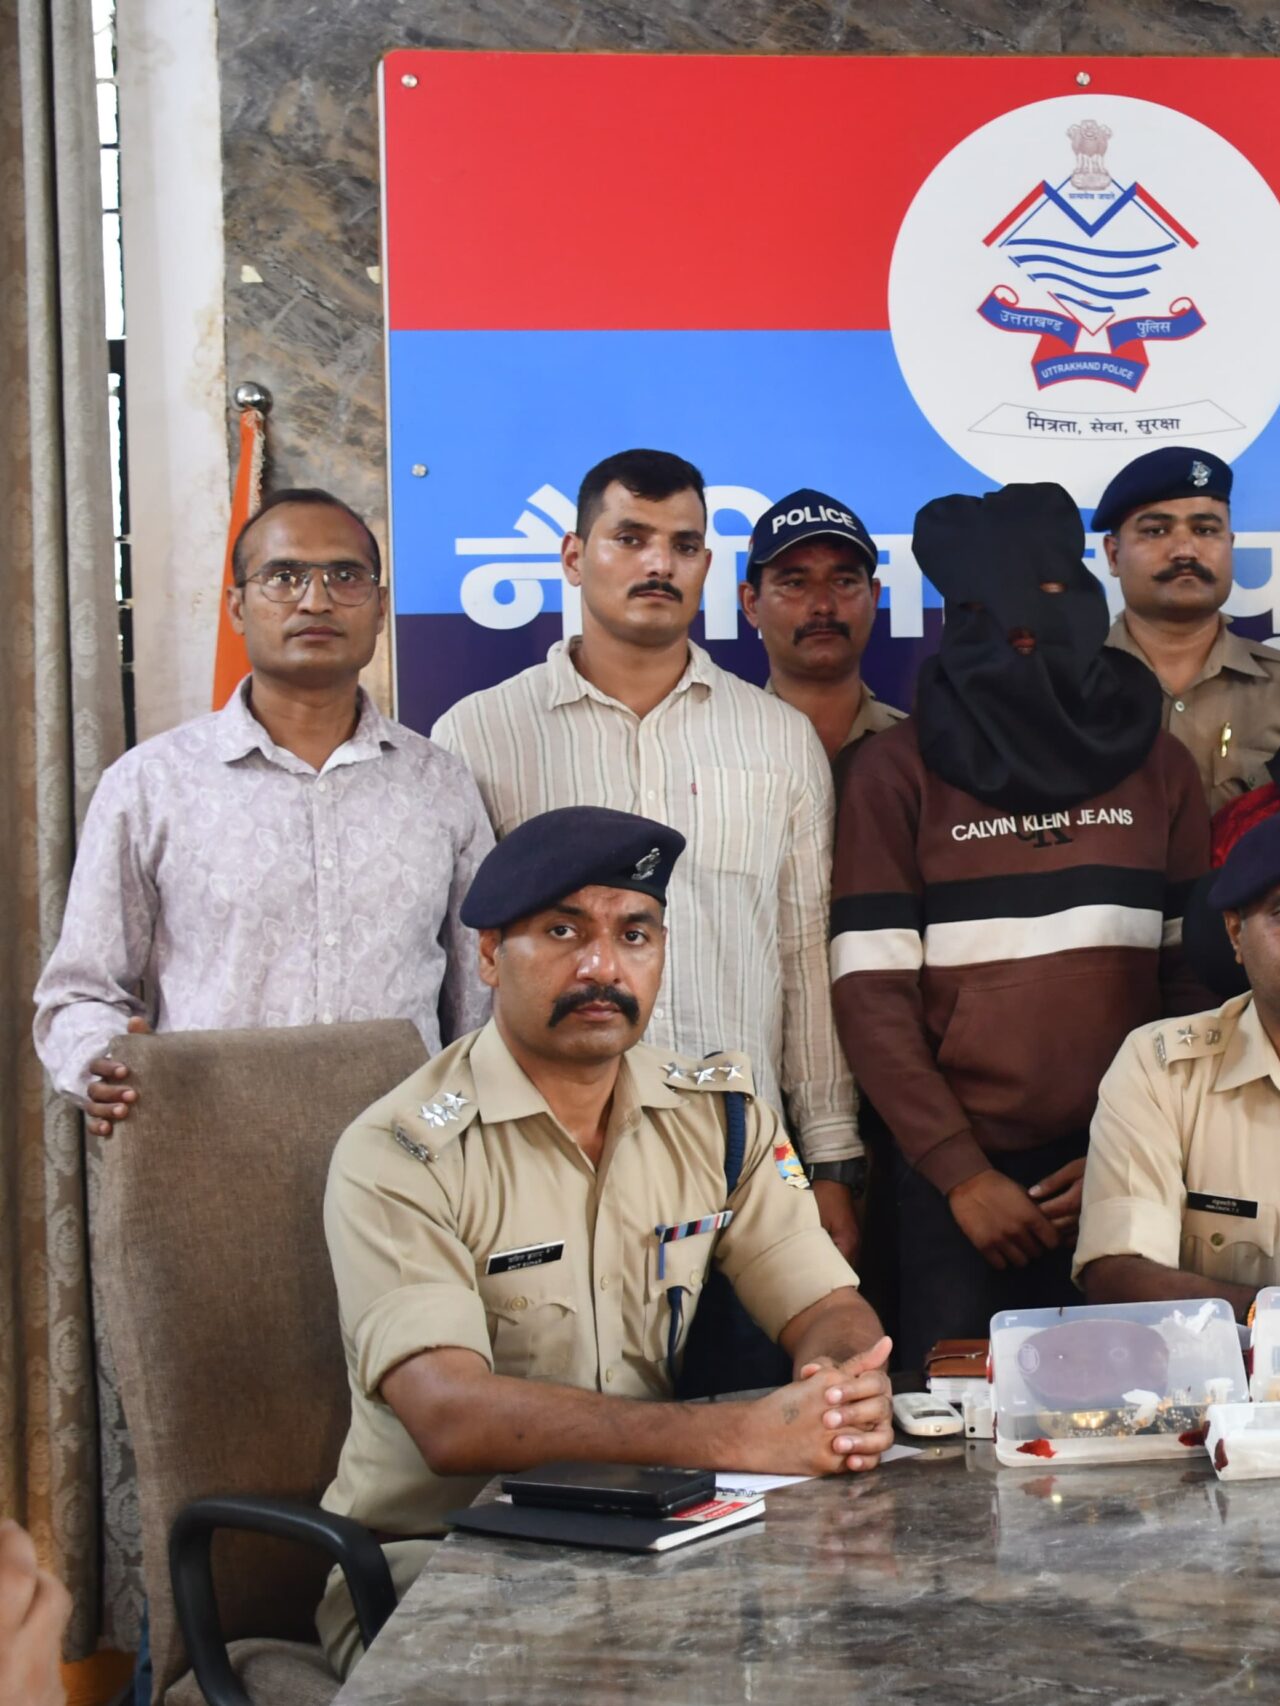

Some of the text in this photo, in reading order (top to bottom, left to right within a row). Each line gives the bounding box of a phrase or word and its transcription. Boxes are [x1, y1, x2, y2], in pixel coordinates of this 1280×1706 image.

[1000, 310, 1063, 331] उत्तराखण्ड
[1136, 320, 1171, 337] पुलिस
[1041, 361, 1135, 380] UTTRAKHAND POLICE
[1026, 411, 1181, 435] मित्रता, सेवा, सुरक्षा
[772, 505, 857, 534] POLICE
[951, 816, 1017, 841] CALVIN
[1022, 810, 1070, 832] KLEIN
[1076, 808, 1133, 825] JEANS
